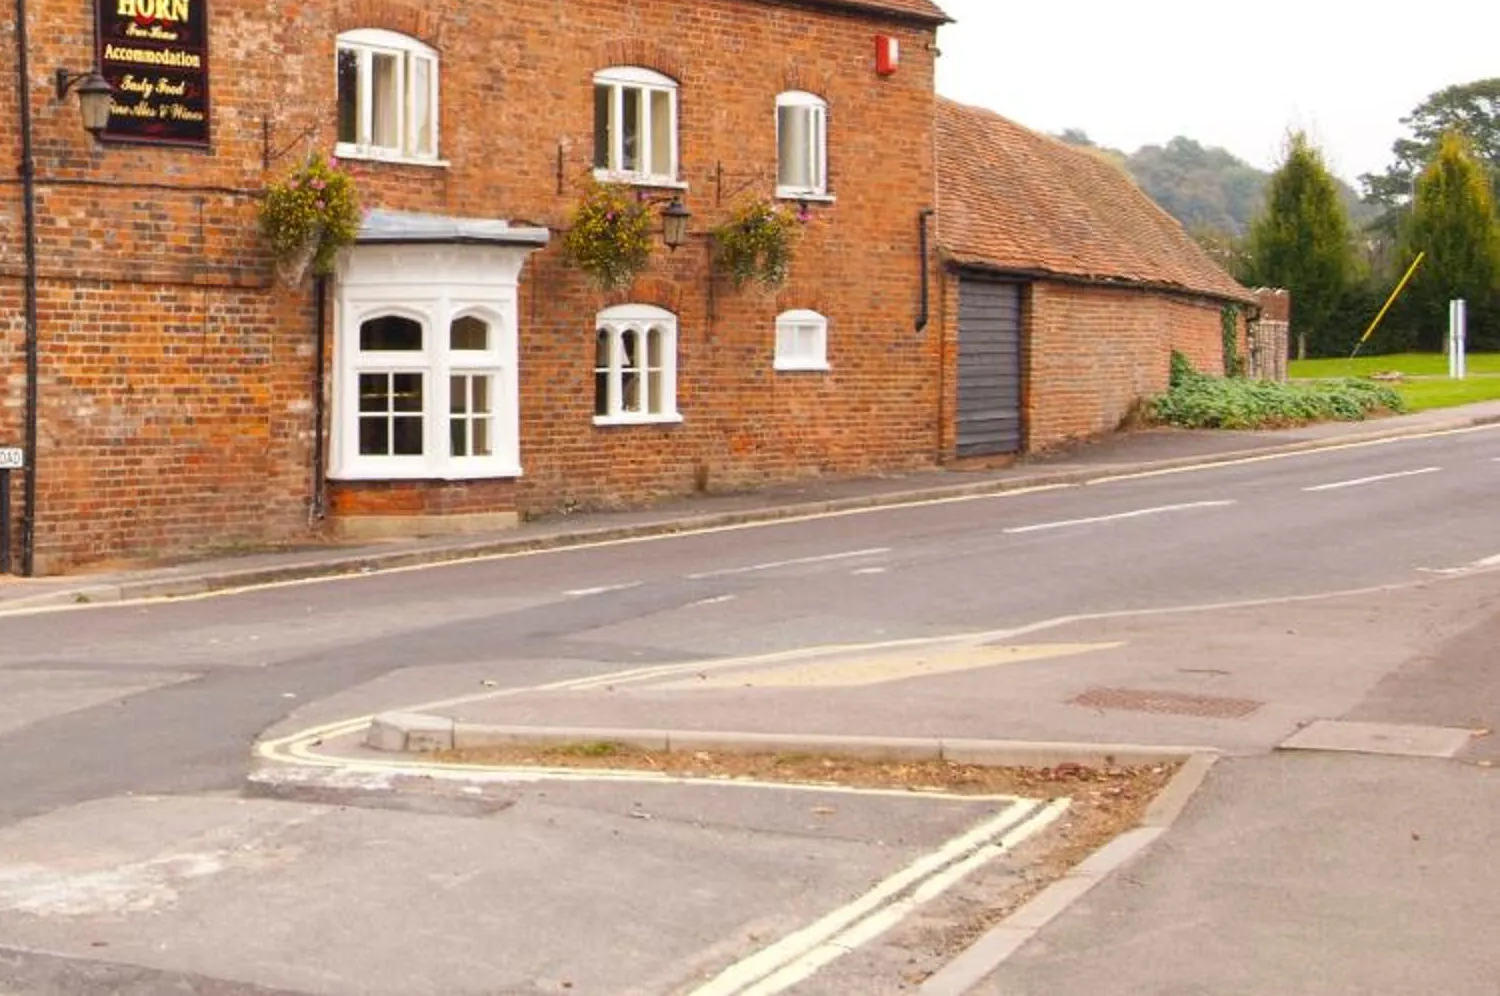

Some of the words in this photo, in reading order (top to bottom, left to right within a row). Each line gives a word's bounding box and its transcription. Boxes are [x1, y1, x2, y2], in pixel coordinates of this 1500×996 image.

[104, 43, 201, 68] Accommodation
[120, 74, 154, 98] Tasty
[156, 77, 185, 96] Food
[109, 101, 133, 116] ine
